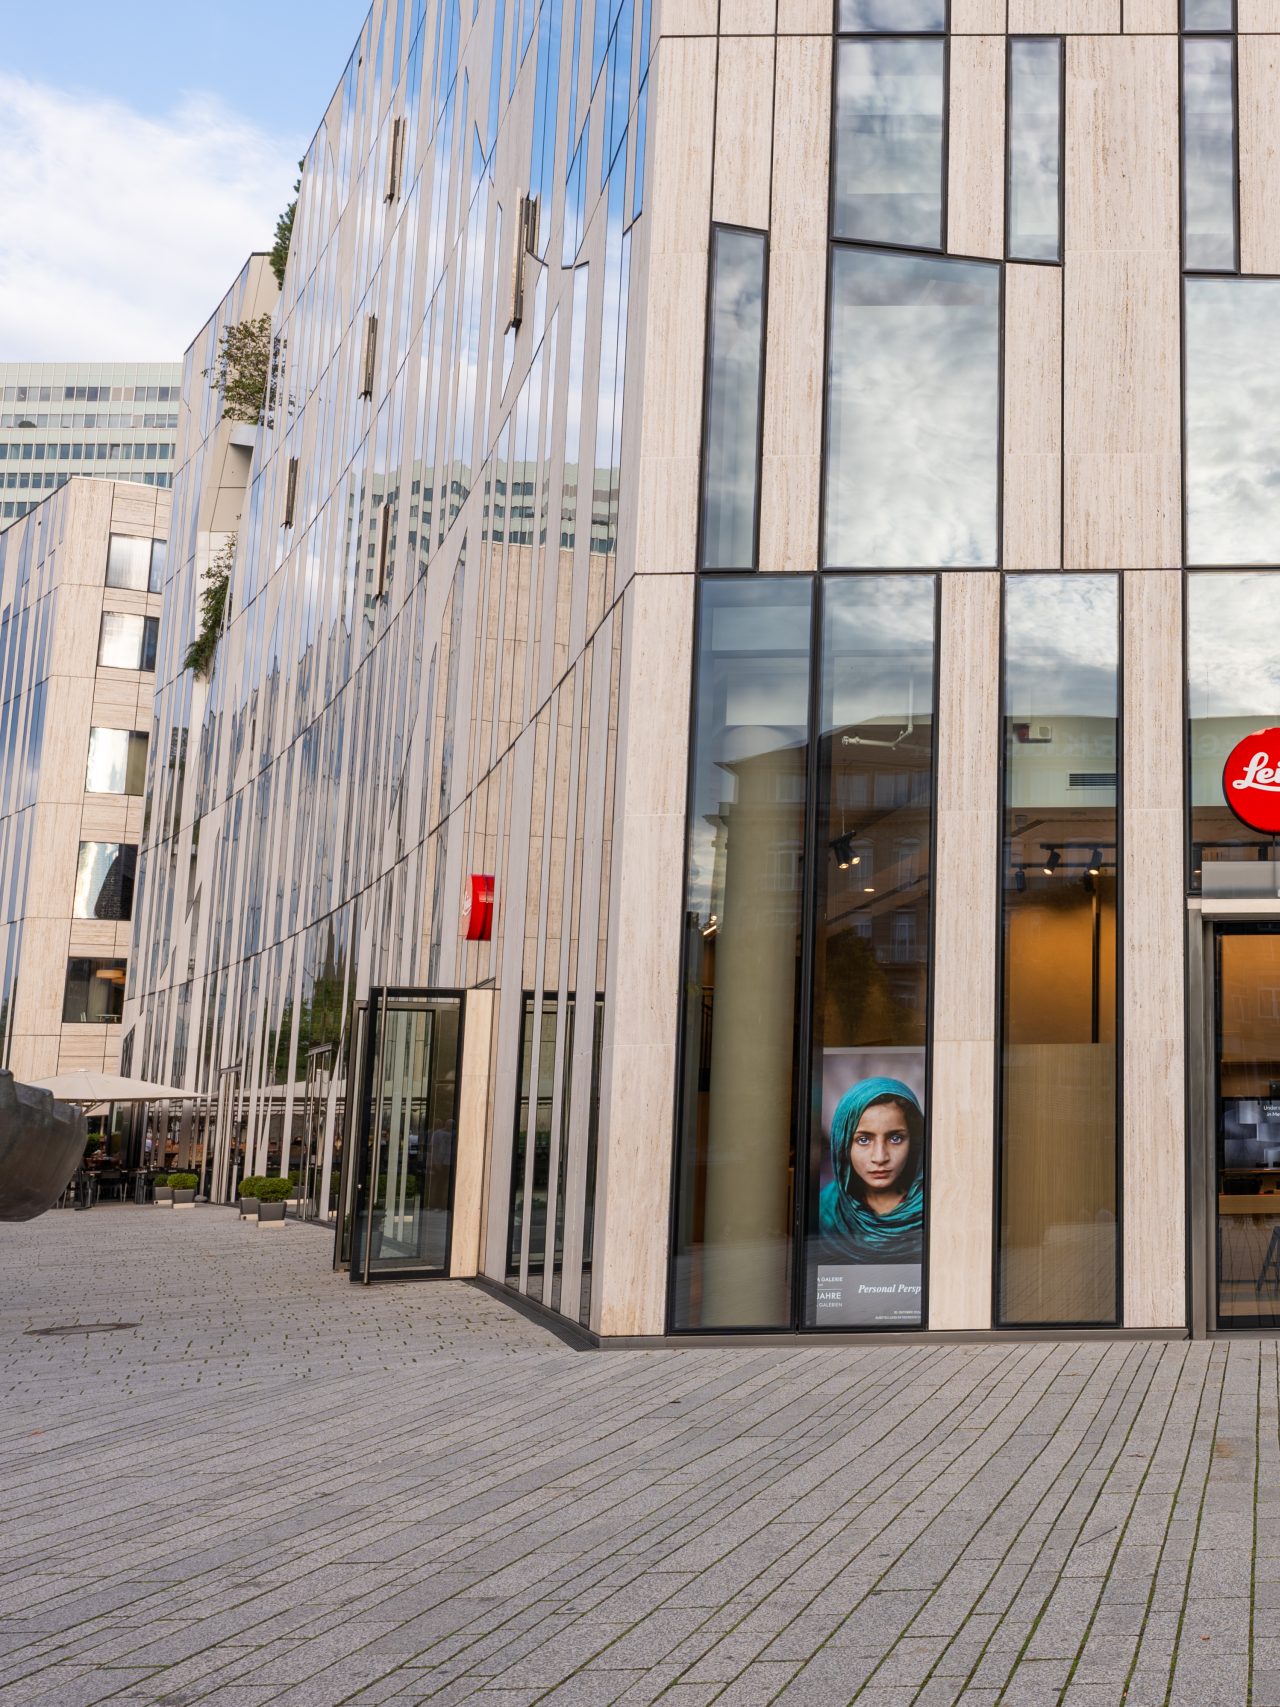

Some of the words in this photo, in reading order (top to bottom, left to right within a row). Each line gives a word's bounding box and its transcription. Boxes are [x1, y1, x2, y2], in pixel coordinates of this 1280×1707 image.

[858, 1284, 896, 1294] Personal
[898, 1284, 921, 1295] Persp
[817, 1292, 842, 1300] JAHRE
